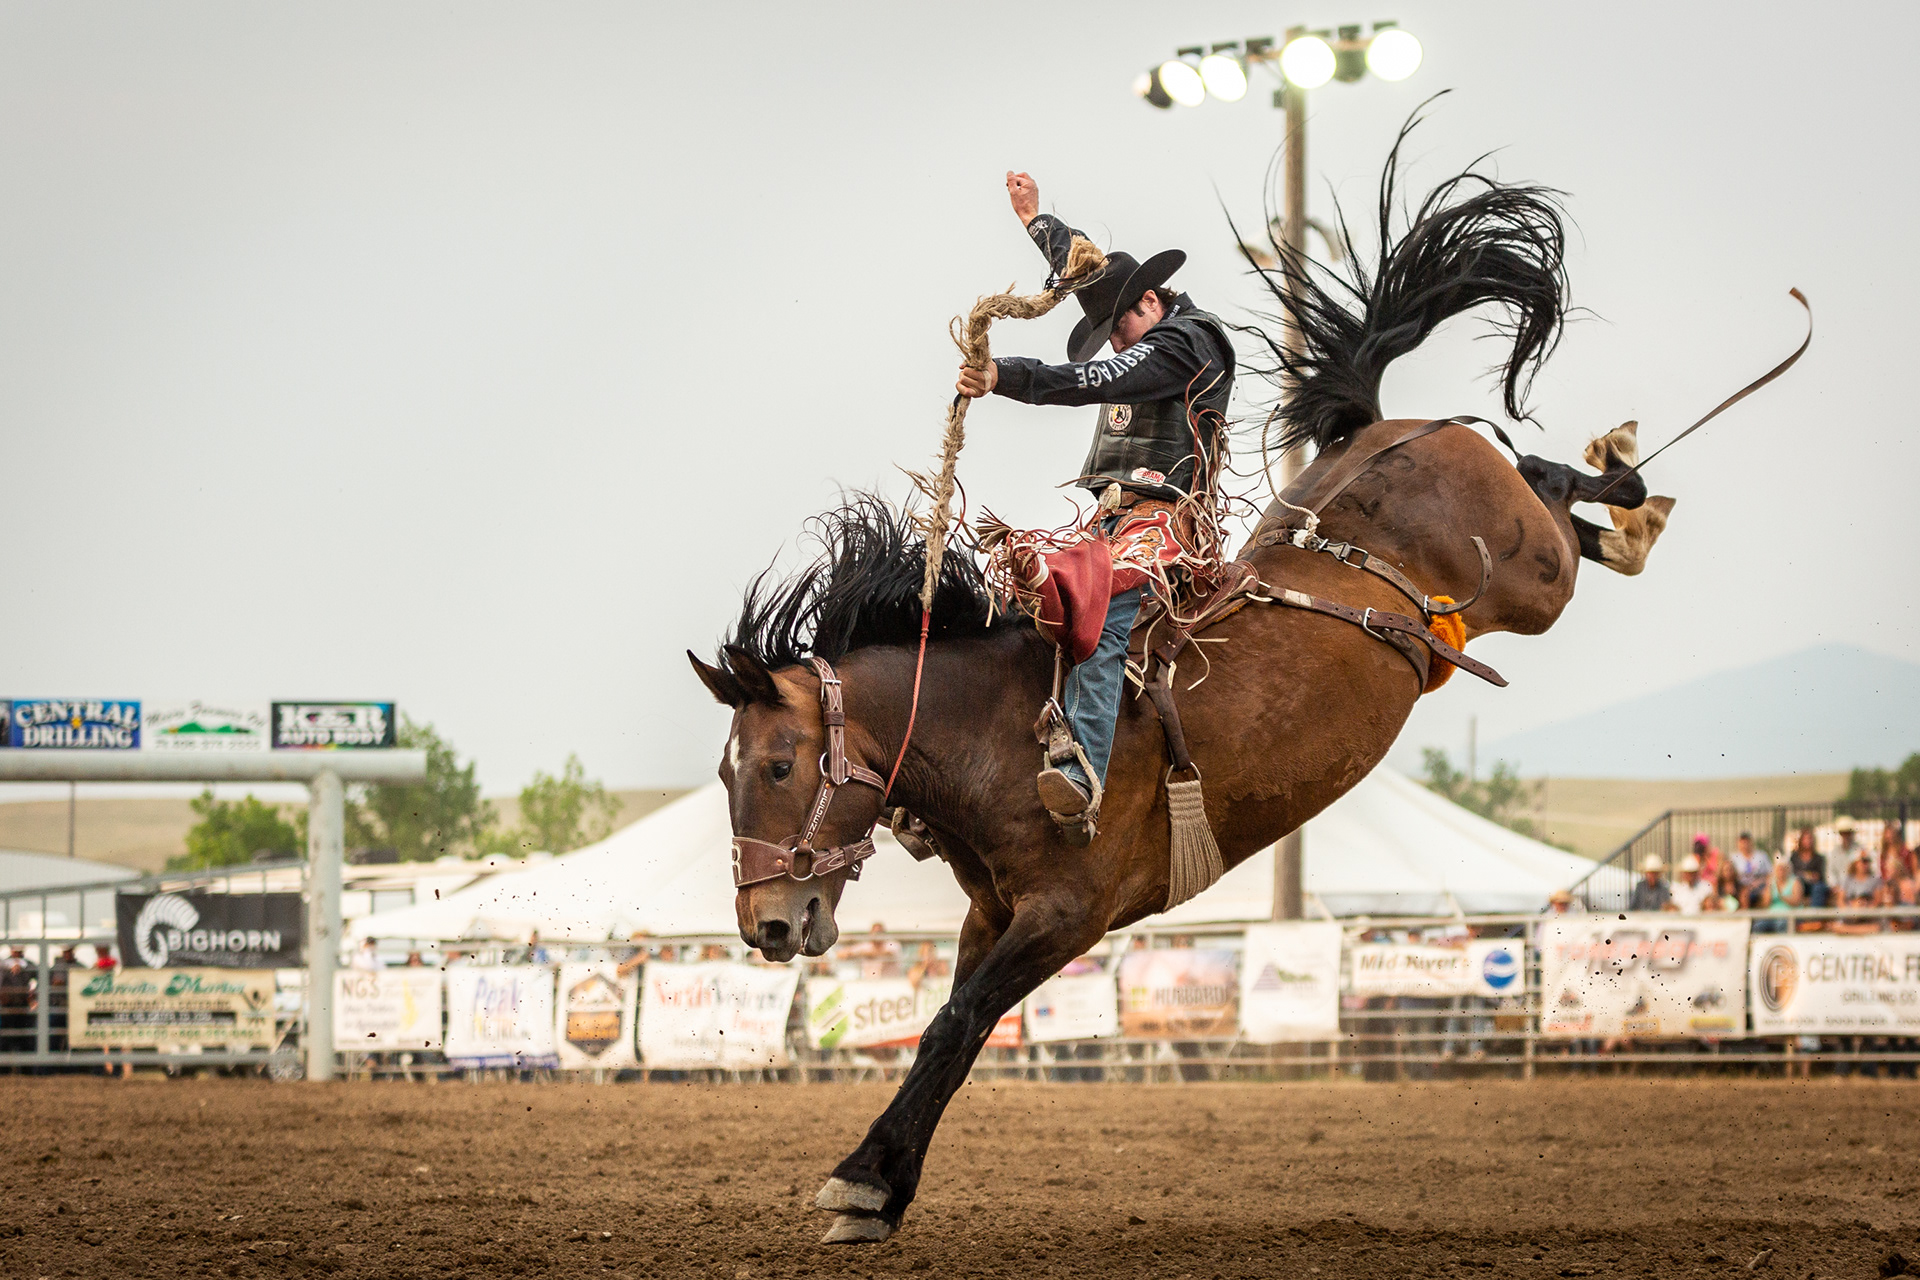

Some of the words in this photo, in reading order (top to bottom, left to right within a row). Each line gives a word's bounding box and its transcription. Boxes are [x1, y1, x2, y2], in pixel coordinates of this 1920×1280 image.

[1074, 342, 1155, 389] HERITAGE
[15, 701, 138, 729] CENTRAL
[23, 725, 133, 748] DRILLING
[805, 788, 829, 841] LEGEND
[168, 929, 281, 953] BIGHORN
[1808, 953, 1899, 983] CENTRAL
[853, 987, 919, 1030] steel
